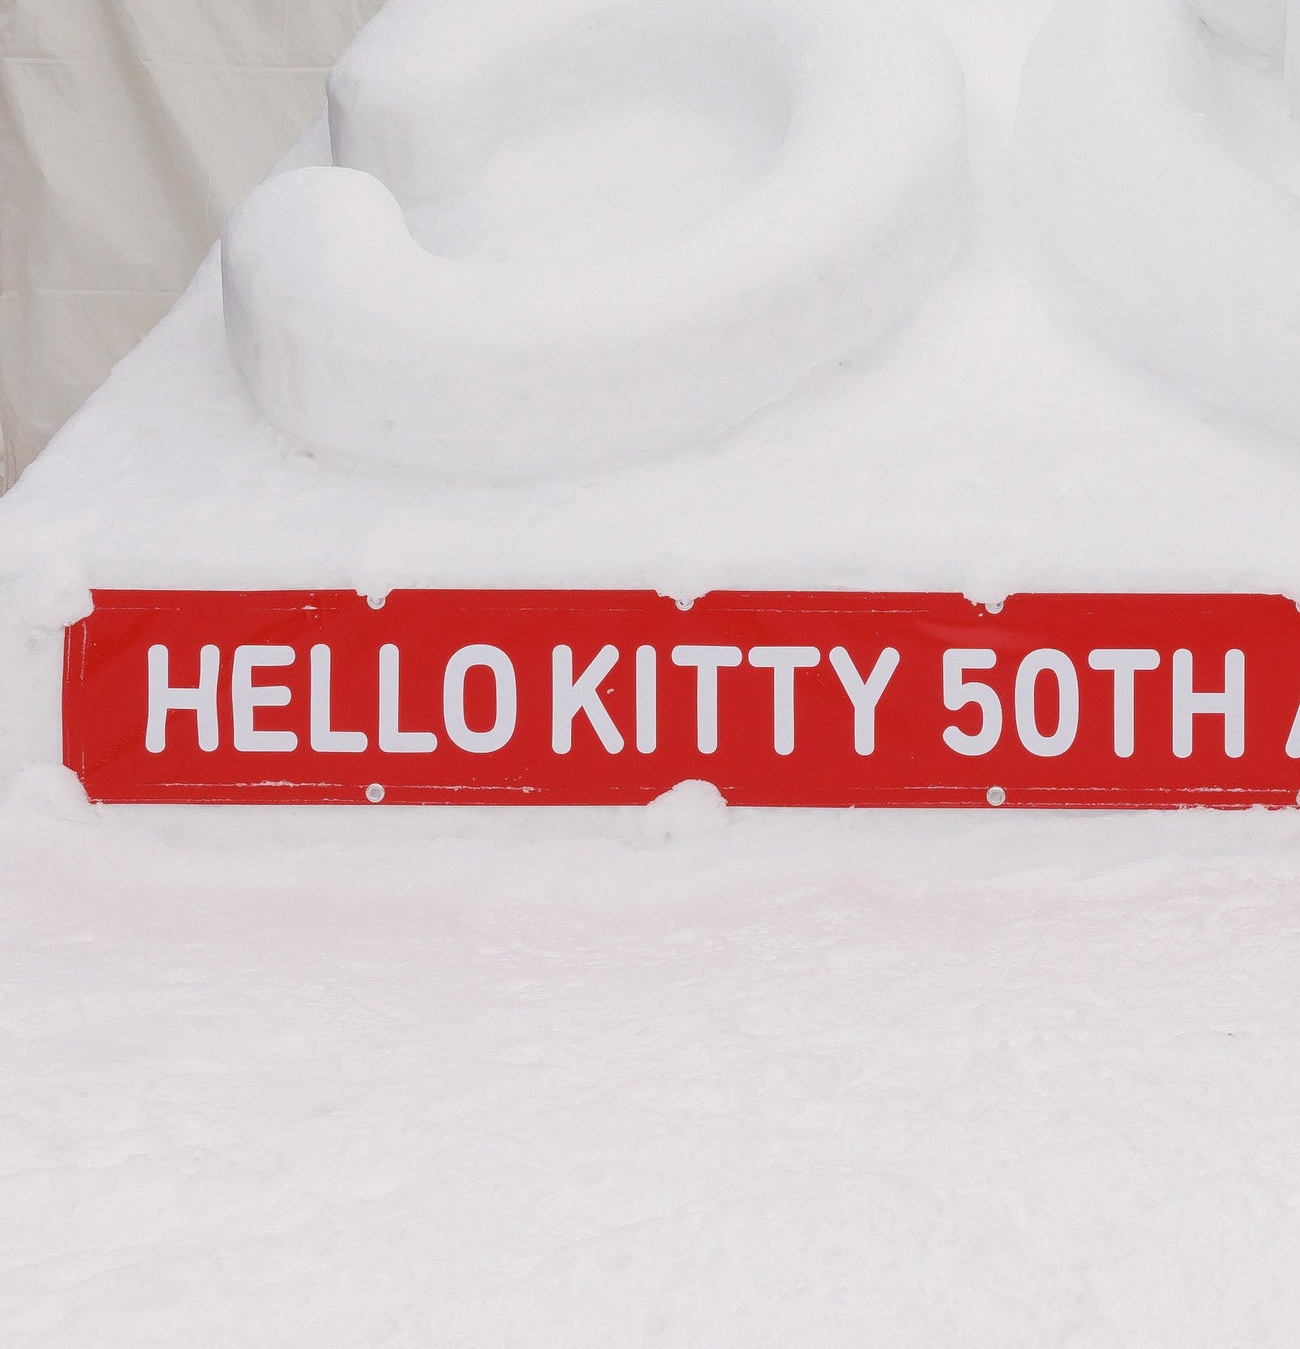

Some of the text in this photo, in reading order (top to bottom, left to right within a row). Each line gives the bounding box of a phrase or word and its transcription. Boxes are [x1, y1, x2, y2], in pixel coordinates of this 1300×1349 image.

[146, 643, 518, 754] HELLO
[551, 644, 902, 757] KITTY
[941, 648, 1246, 759] 50TH
